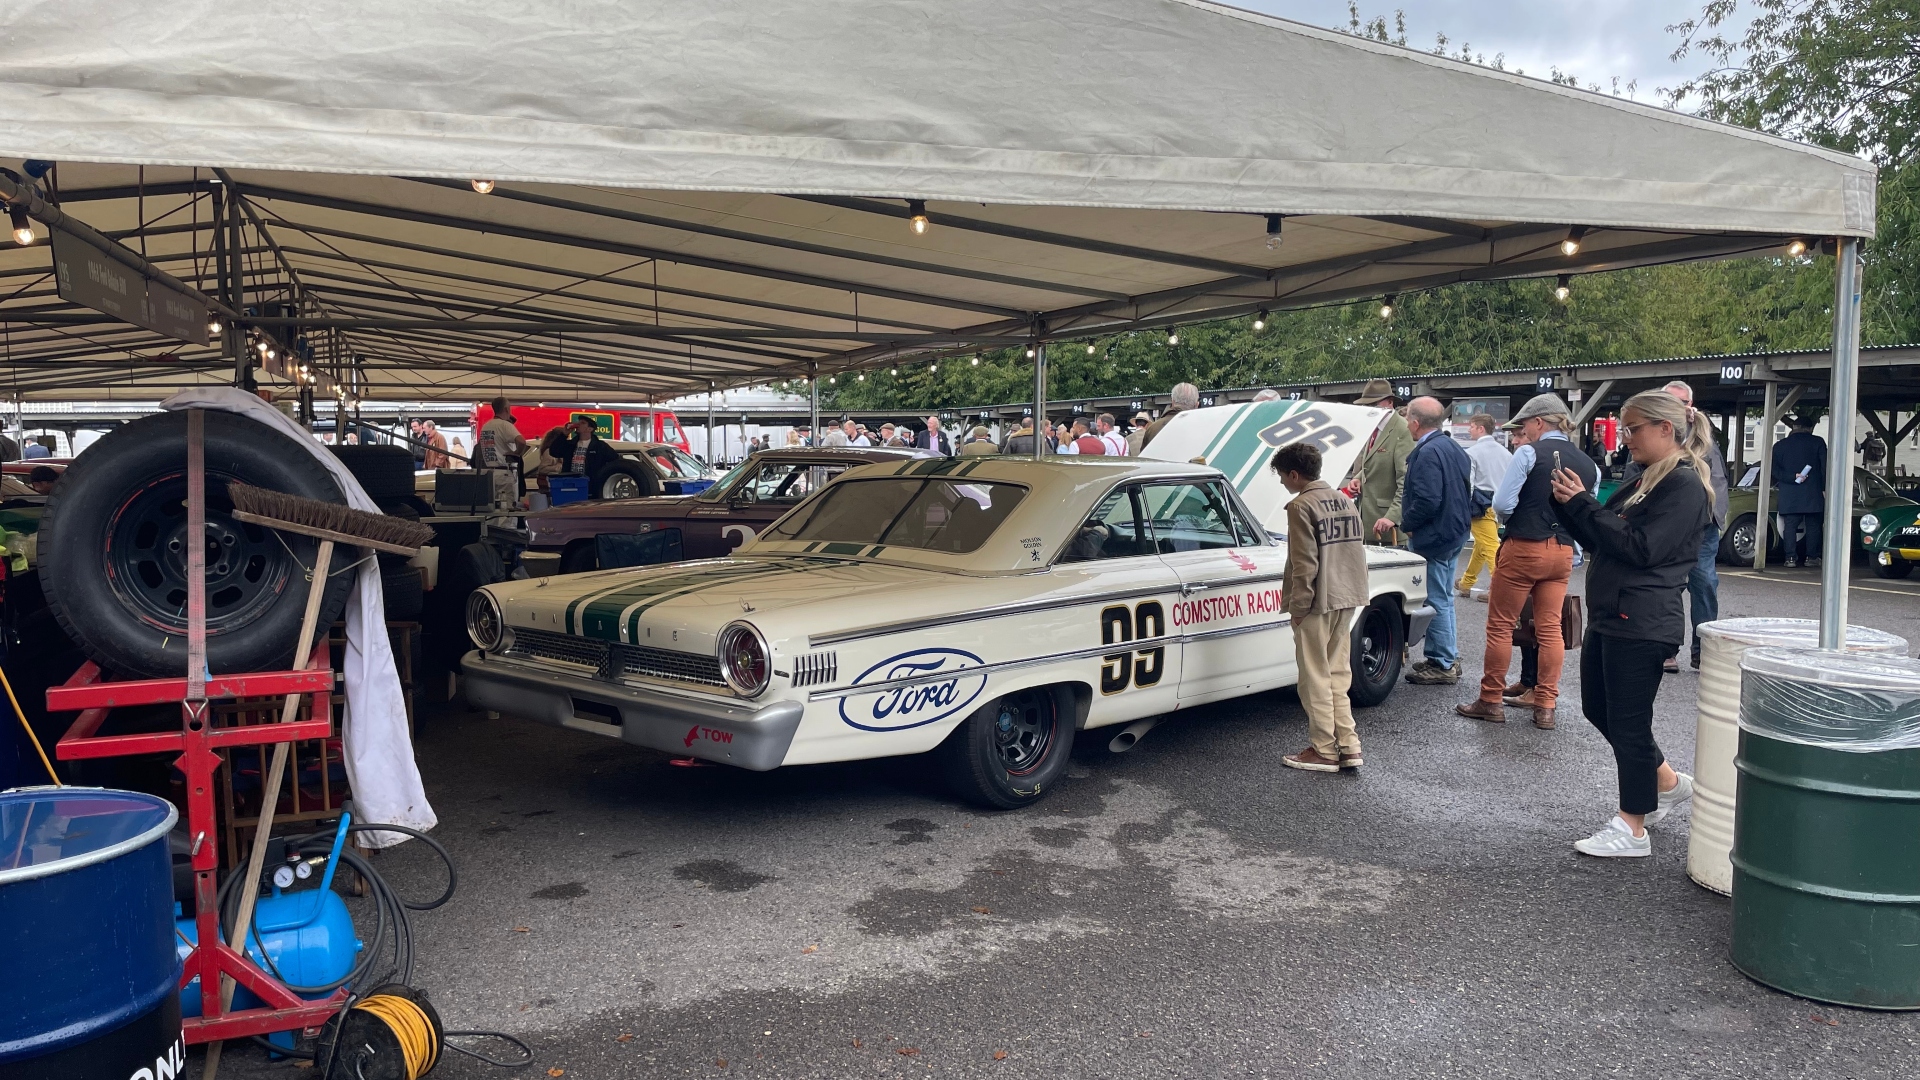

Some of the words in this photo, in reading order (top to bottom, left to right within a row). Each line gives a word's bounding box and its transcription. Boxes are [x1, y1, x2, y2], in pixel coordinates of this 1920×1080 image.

[1720, 366, 1743, 379] 100
[1538, 377, 1552, 388] 99
[1290, 392, 1301, 400] 97
[1398, 386, 1410, 396] 98
[1131, 401, 1142, 410] 95
[1202, 397, 1213, 406] 96
[1023, 407, 1032, 415] 93
[1073, 405, 1082, 413] 94
[1320, 498, 1350, 513] TEAM
[1172, 594, 1243, 627] COMSTOCK
[1247, 589, 1283, 615] RACIN
[1099, 599, 1166, 697] 99
[872, 656, 966, 720] Ford
[701, 727, 734, 744] TOW
